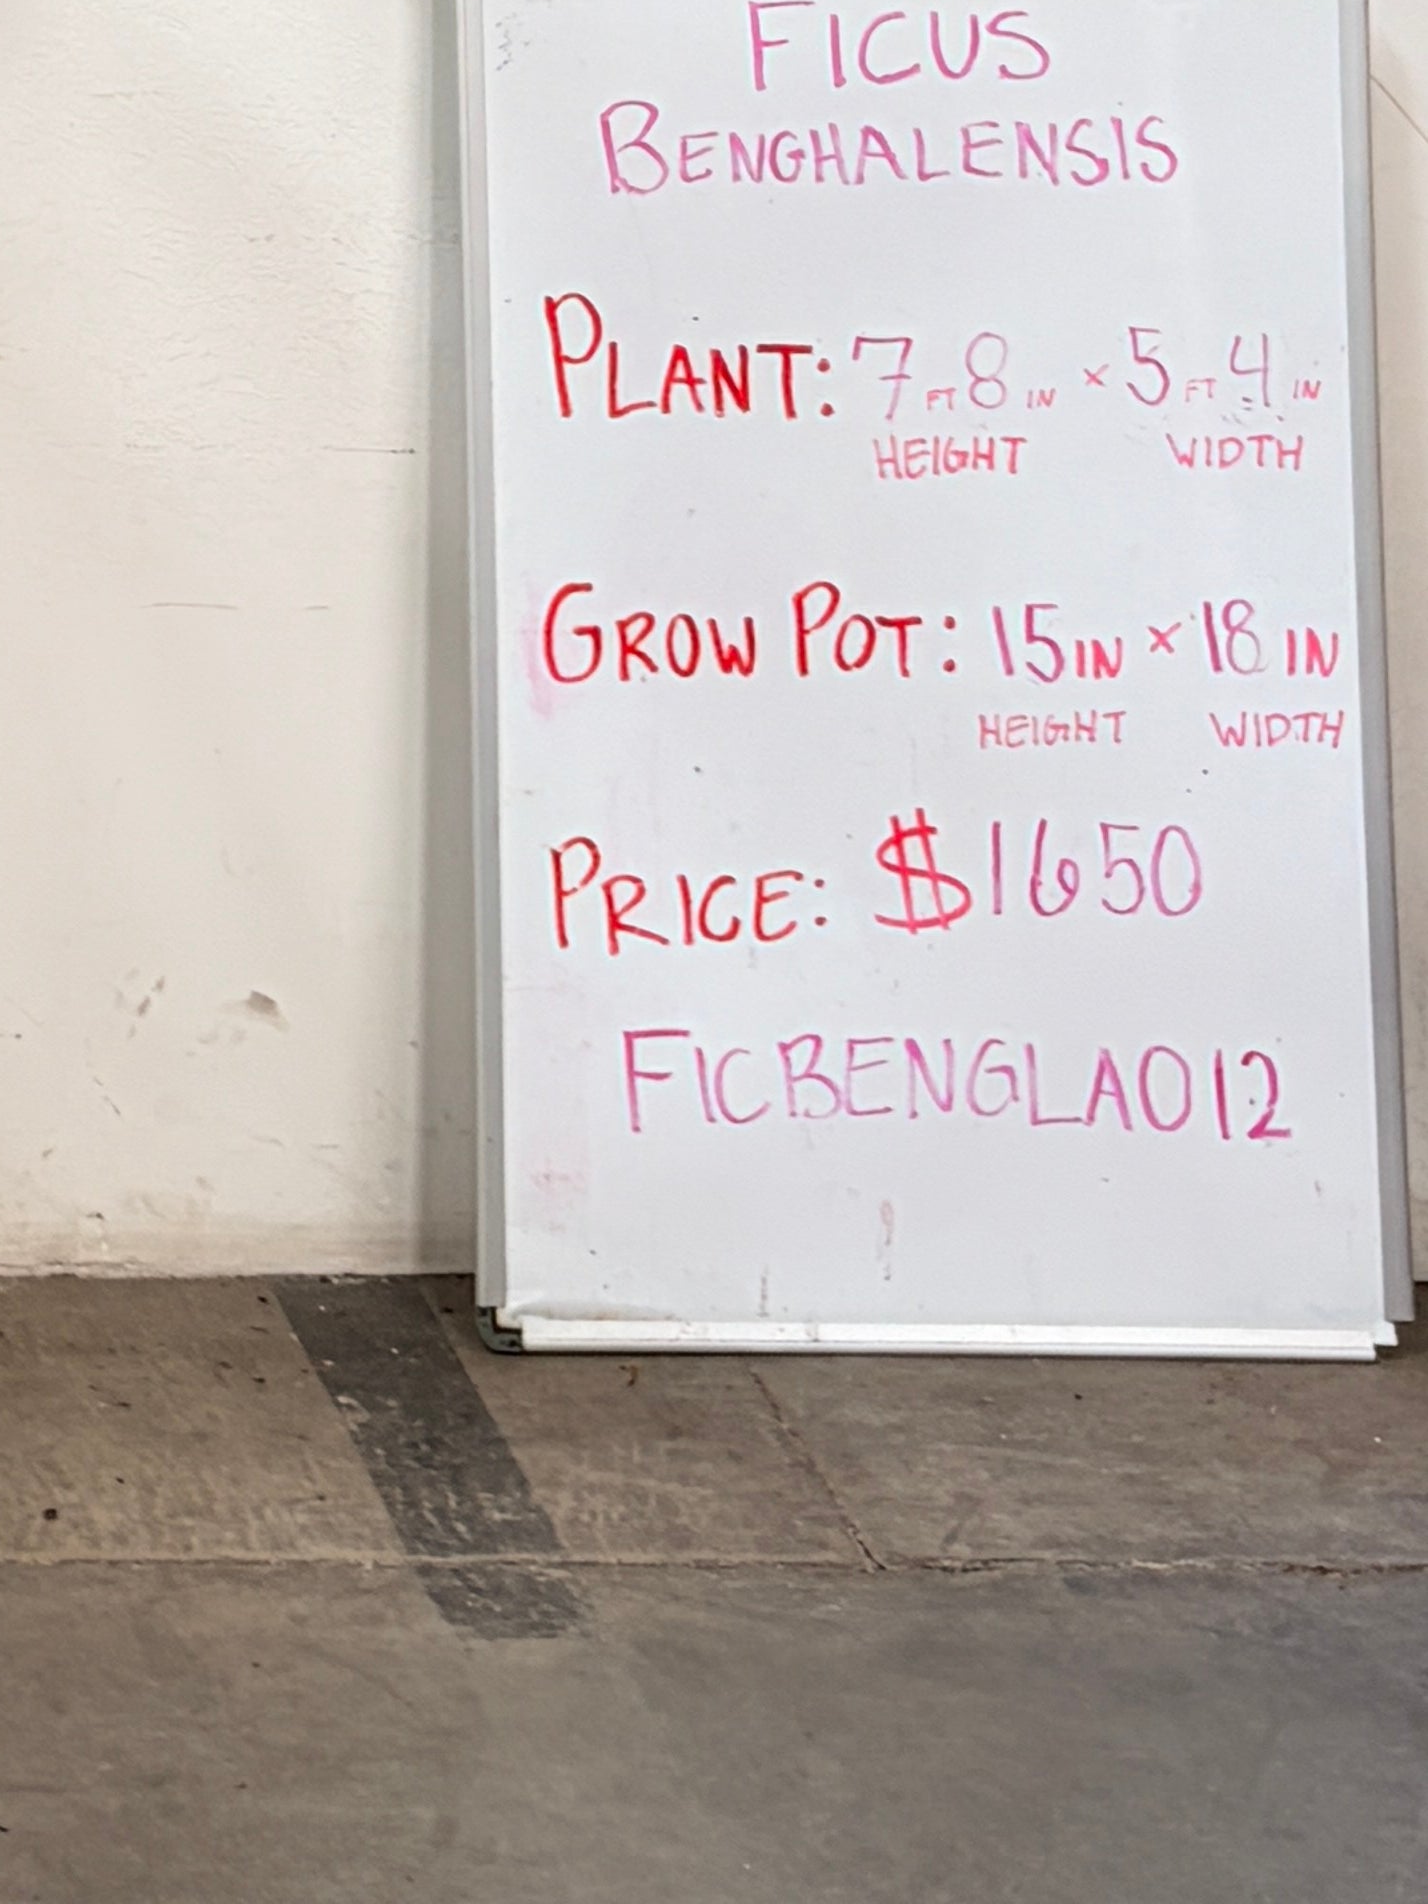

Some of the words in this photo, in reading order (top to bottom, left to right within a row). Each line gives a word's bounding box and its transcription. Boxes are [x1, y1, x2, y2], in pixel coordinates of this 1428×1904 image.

[747, 0, 1052, 91] FICUS
[598, 100, 1179, 196] BENGHALENSIS
[542, 292, 835, 421] PLANT:
[873, 433, 1028, 480] HEIGHT
[1165, 433, 1305, 471] WIDTH
[542, 582, 758, 684] GROW
[791, 580, 958, 680] POT:
[977, 711, 1126, 750] HEIGHT
[1209, 711, 1345, 749] WIDTH
[548, 836, 828, 956] PRICE:
[873, 807, 1203, 935] $1650
